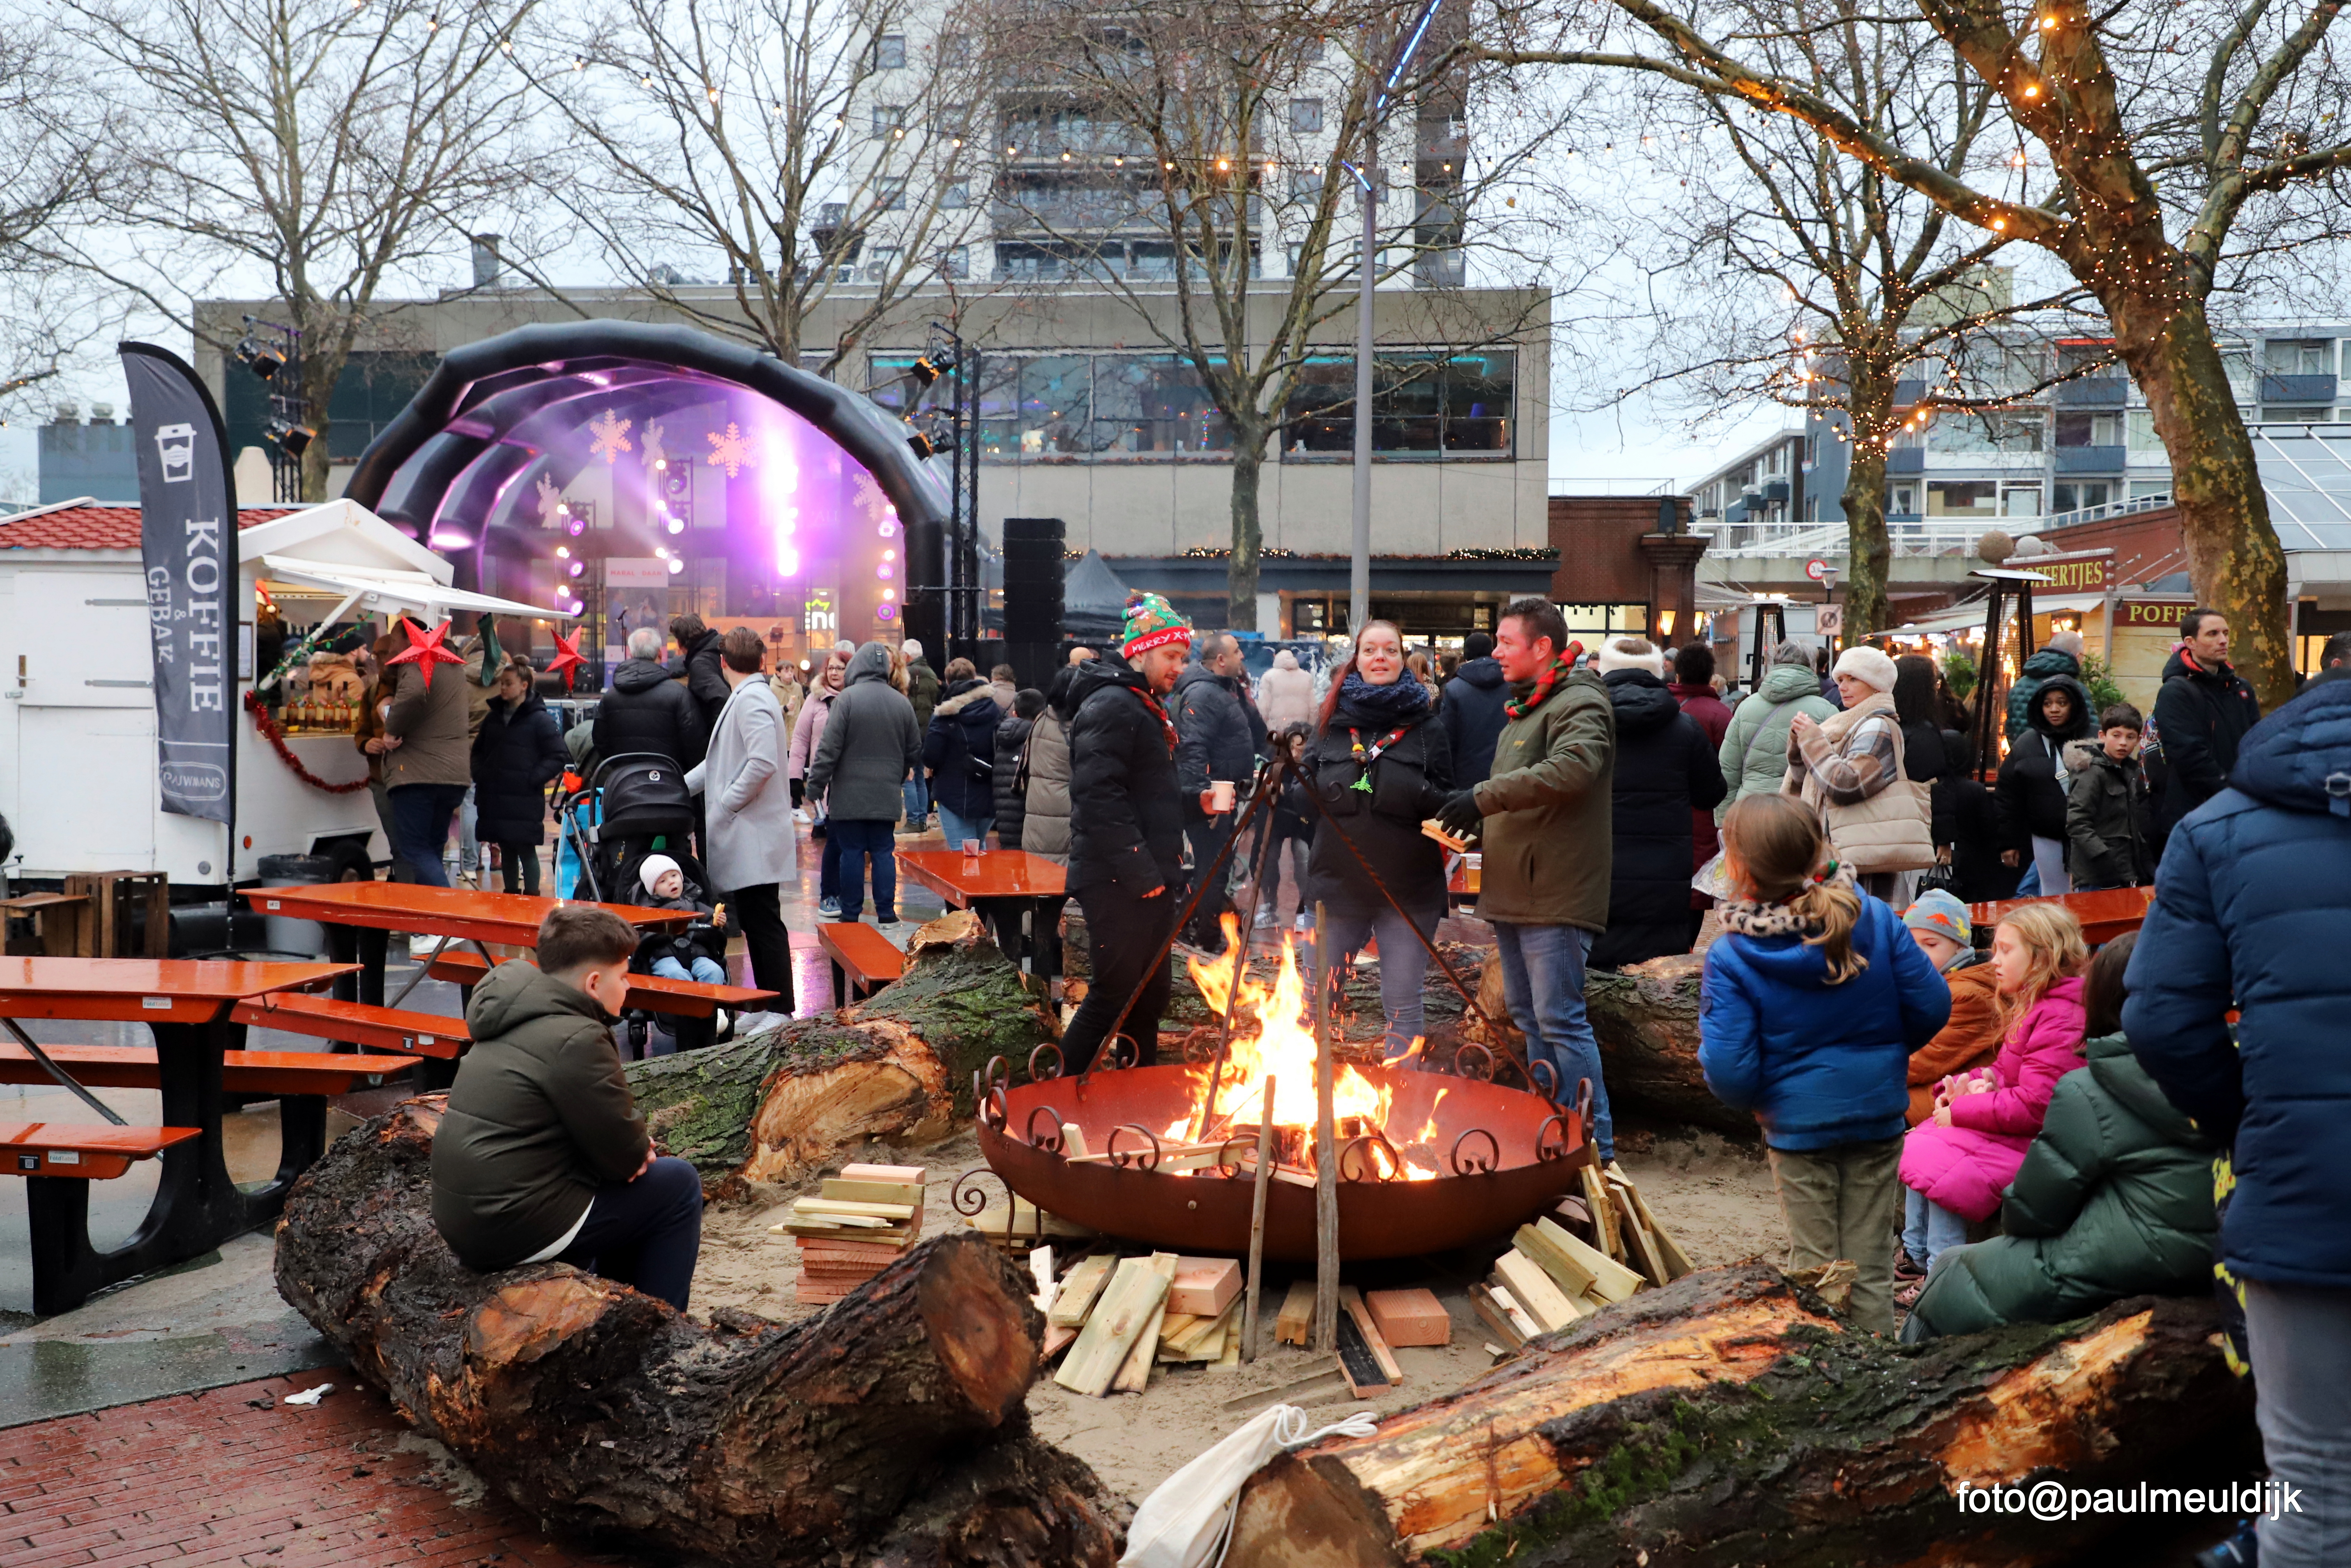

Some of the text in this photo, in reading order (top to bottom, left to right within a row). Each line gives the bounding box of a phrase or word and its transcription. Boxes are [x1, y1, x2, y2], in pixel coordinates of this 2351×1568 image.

[2016, 561, 2103, 591] FFERTJES
[148, 566, 173, 663] GEBAK
[174, 609, 186, 621] &
[186, 517, 223, 712] KOFFIE
[2129, 605, 2197, 622] POFF
[1132, 634, 1171, 653] MERRY
